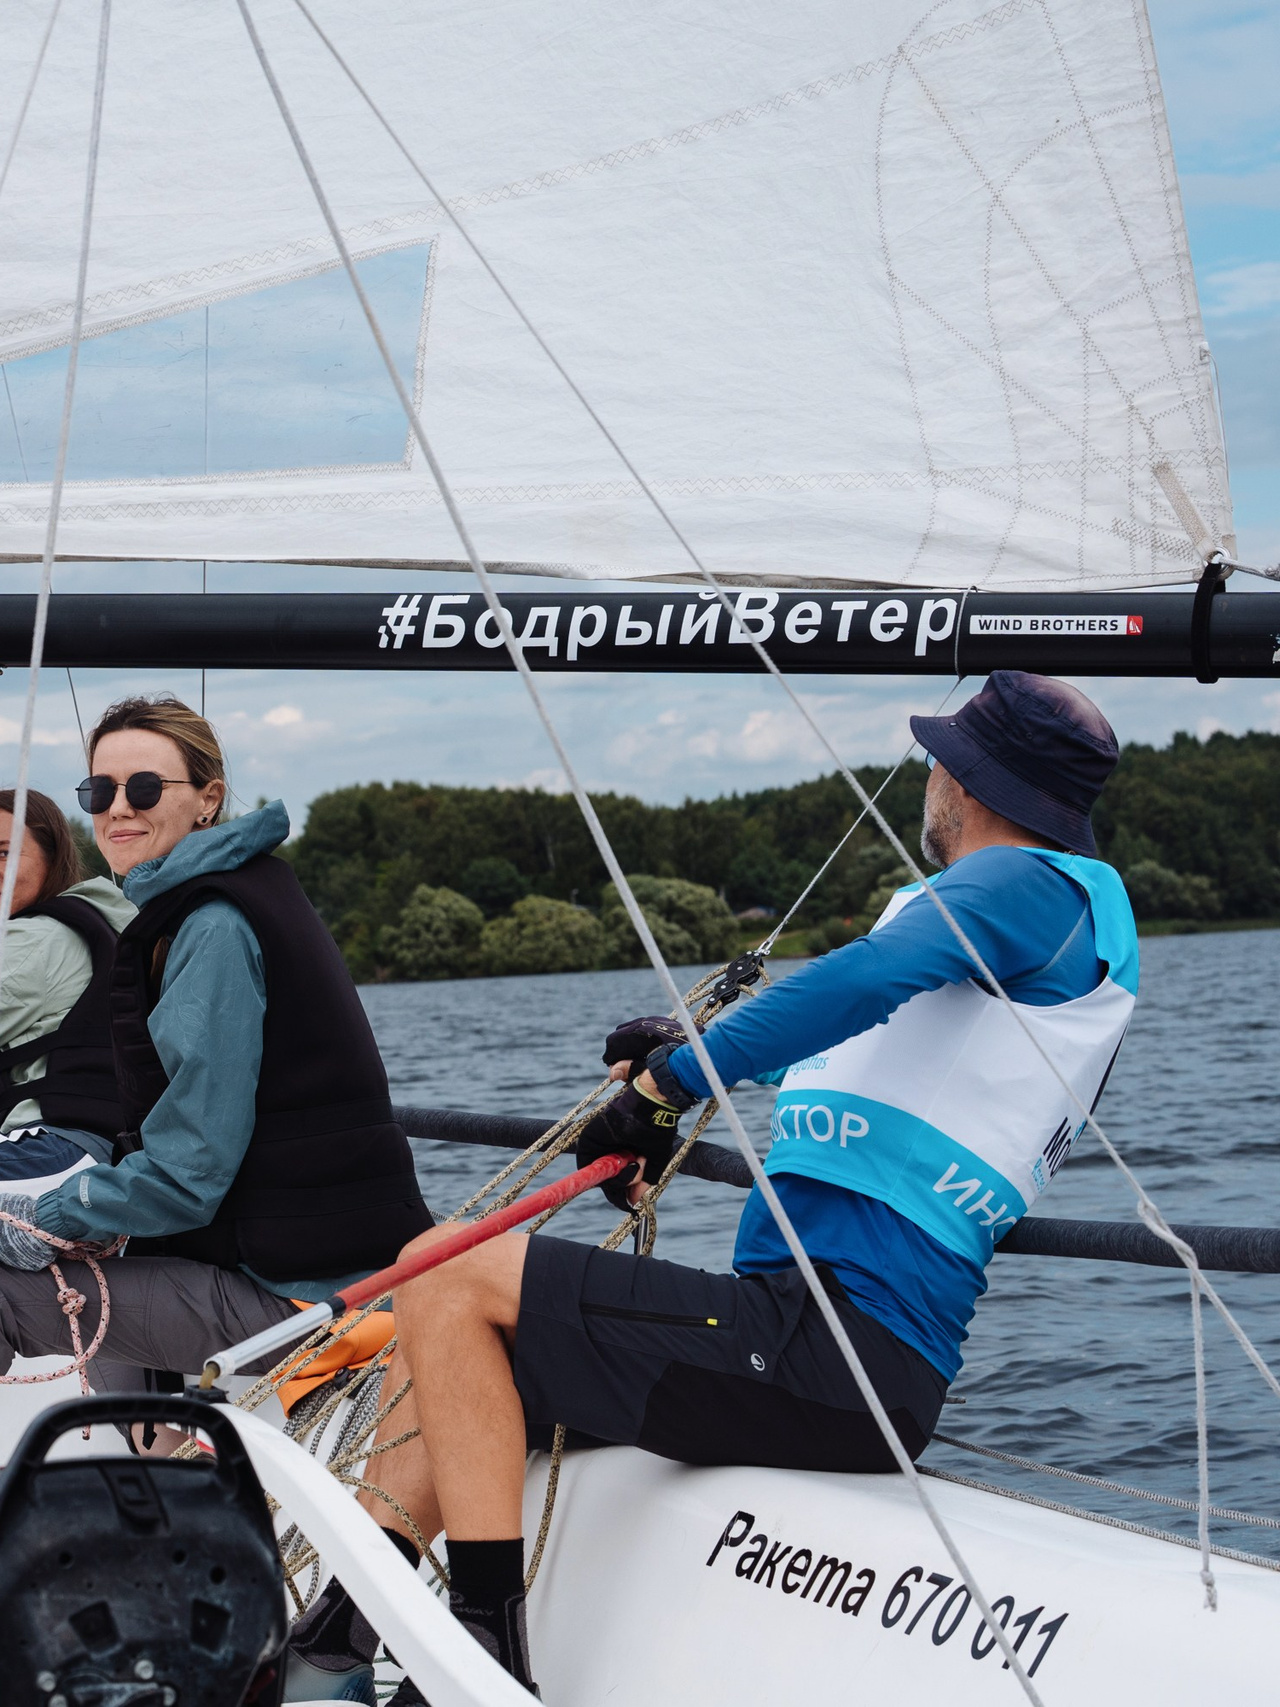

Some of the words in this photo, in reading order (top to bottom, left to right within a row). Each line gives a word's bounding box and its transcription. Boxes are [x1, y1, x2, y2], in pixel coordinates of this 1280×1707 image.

[378, 591, 958, 661] #БодрыйВетер
[978, 618, 1022, 631] WIND
[1029, 618, 1119, 631] BROTHERS
[705, 1510, 876, 1617] Ракета
[880, 1565, 973, 1647] 670
[970, 1595, 1070, 1679] 011
